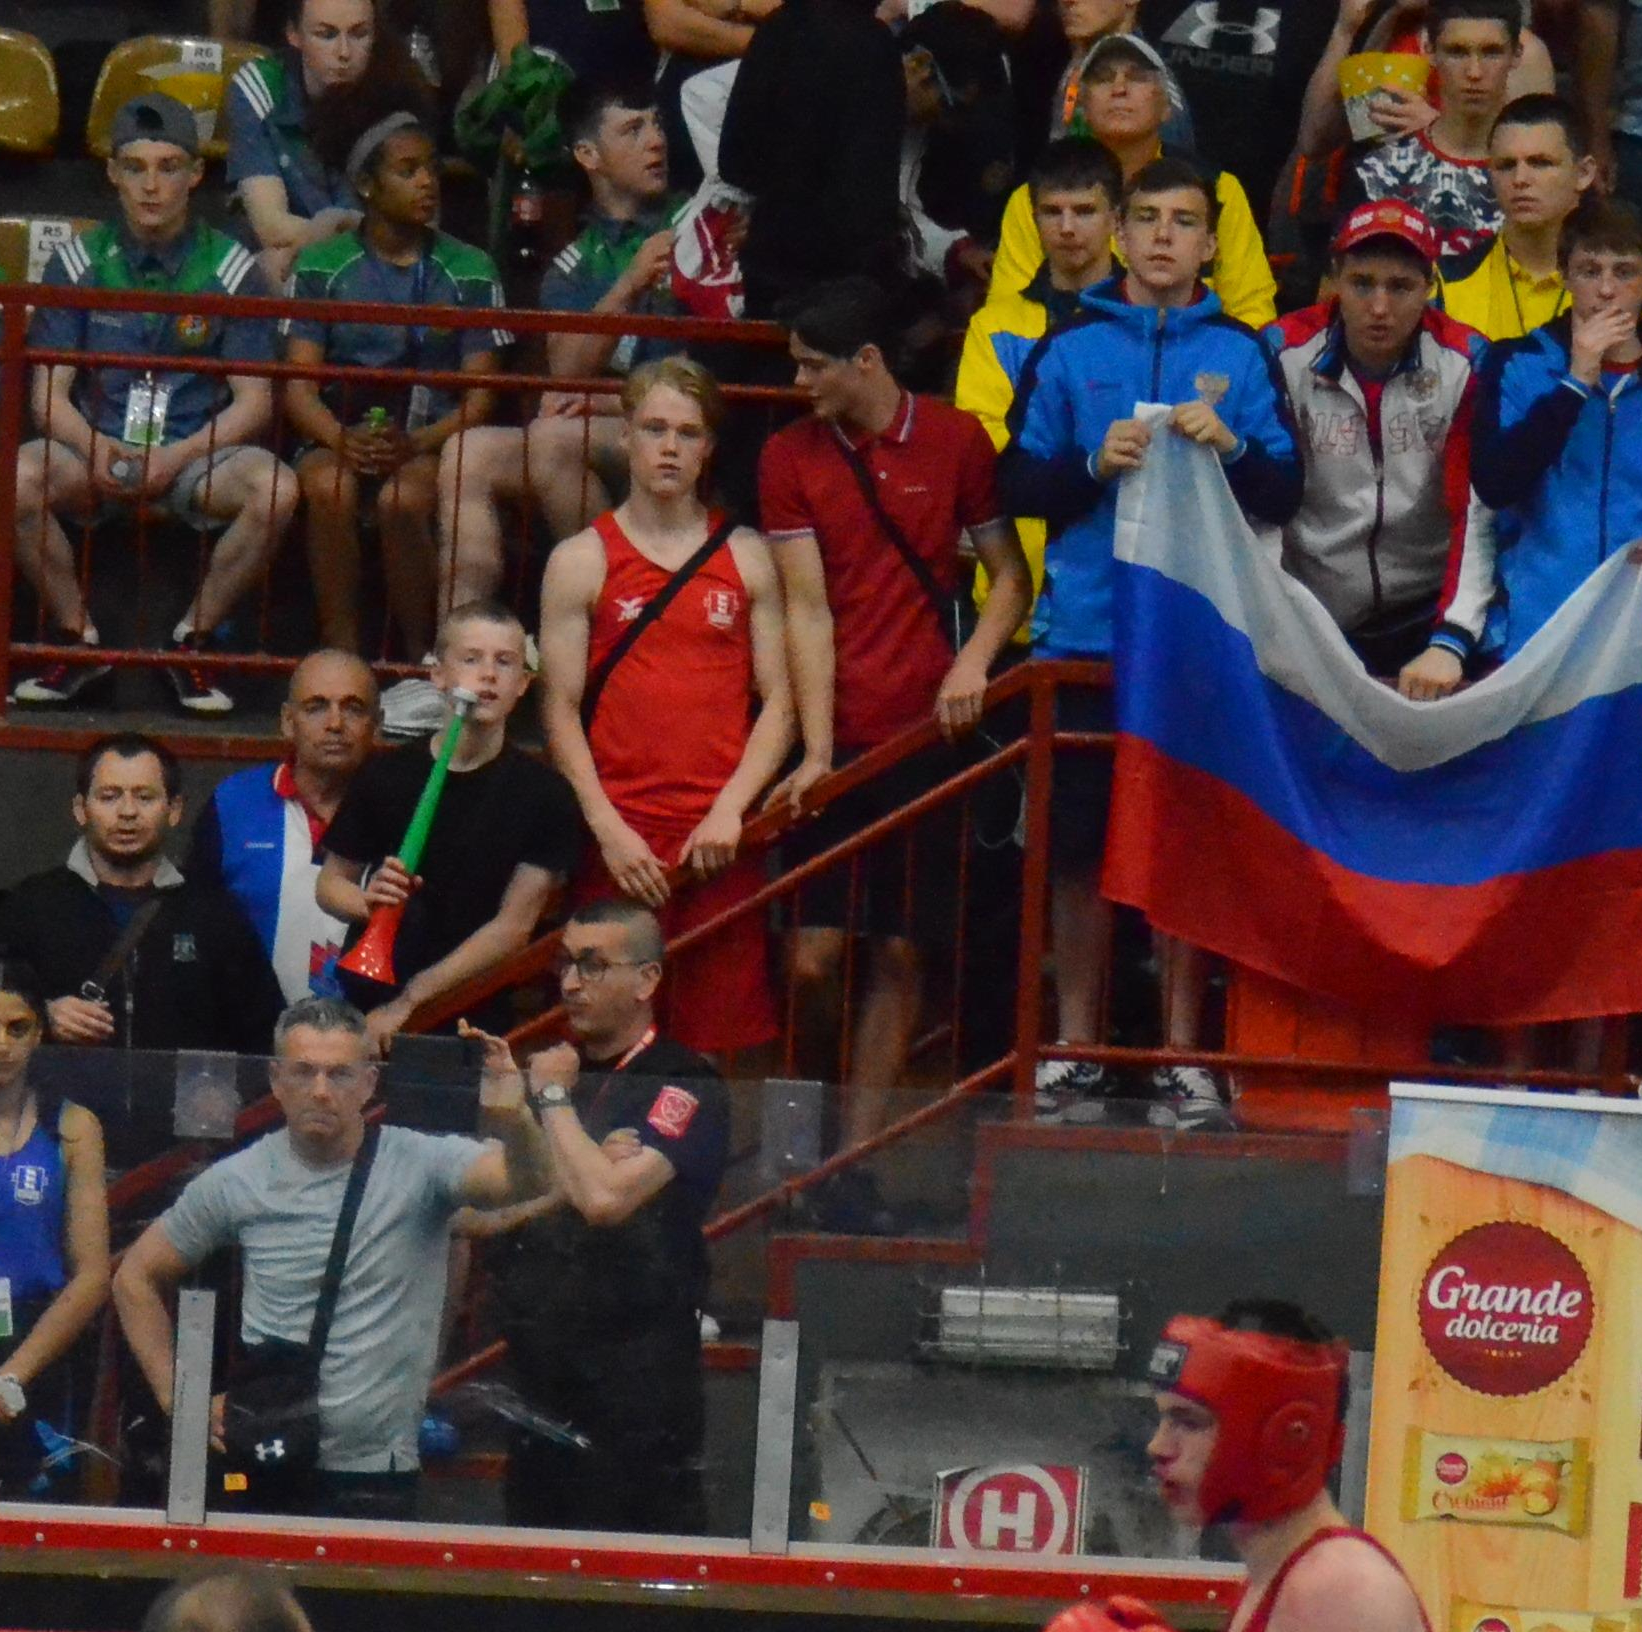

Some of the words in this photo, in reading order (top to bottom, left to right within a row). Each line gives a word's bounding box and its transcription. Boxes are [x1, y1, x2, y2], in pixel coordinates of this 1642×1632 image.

[1427, 1265, 1583, 1319] Grande
[1444, 1312, 1560, 1345] dolceria
[978, 1489, 1041, 1549] H
